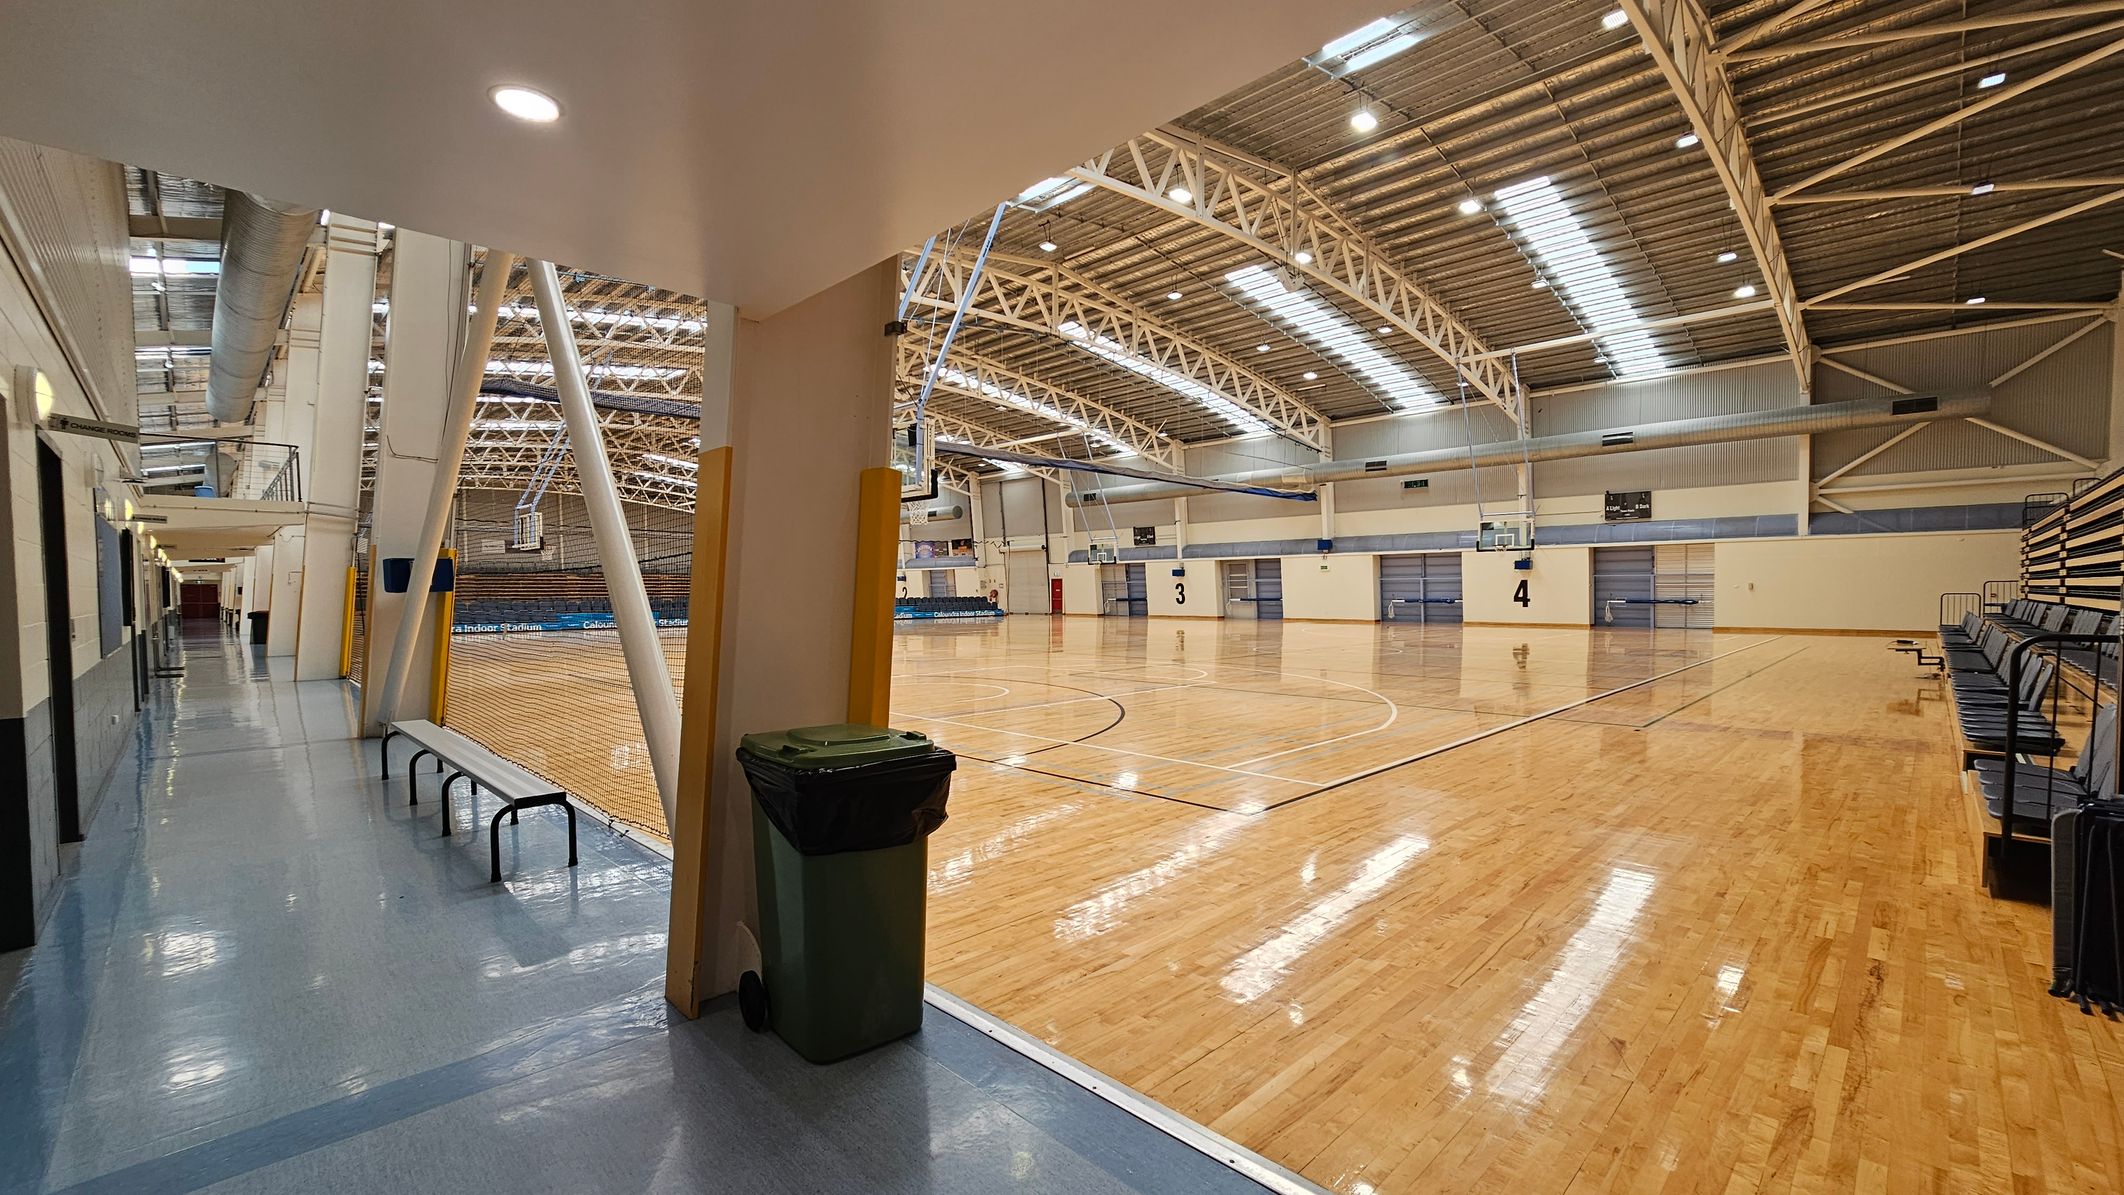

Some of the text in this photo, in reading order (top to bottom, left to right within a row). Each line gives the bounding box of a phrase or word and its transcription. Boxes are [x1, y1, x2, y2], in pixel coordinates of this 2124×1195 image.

[70, 422, 137, 438] CHANGE ROOMS
[1175, 582, 1186, 605] 3
[1513, 579, 1531, 608] 4
[464, 624, 498, 633] Indoor
[500, 622, 543, 632] Stadium
